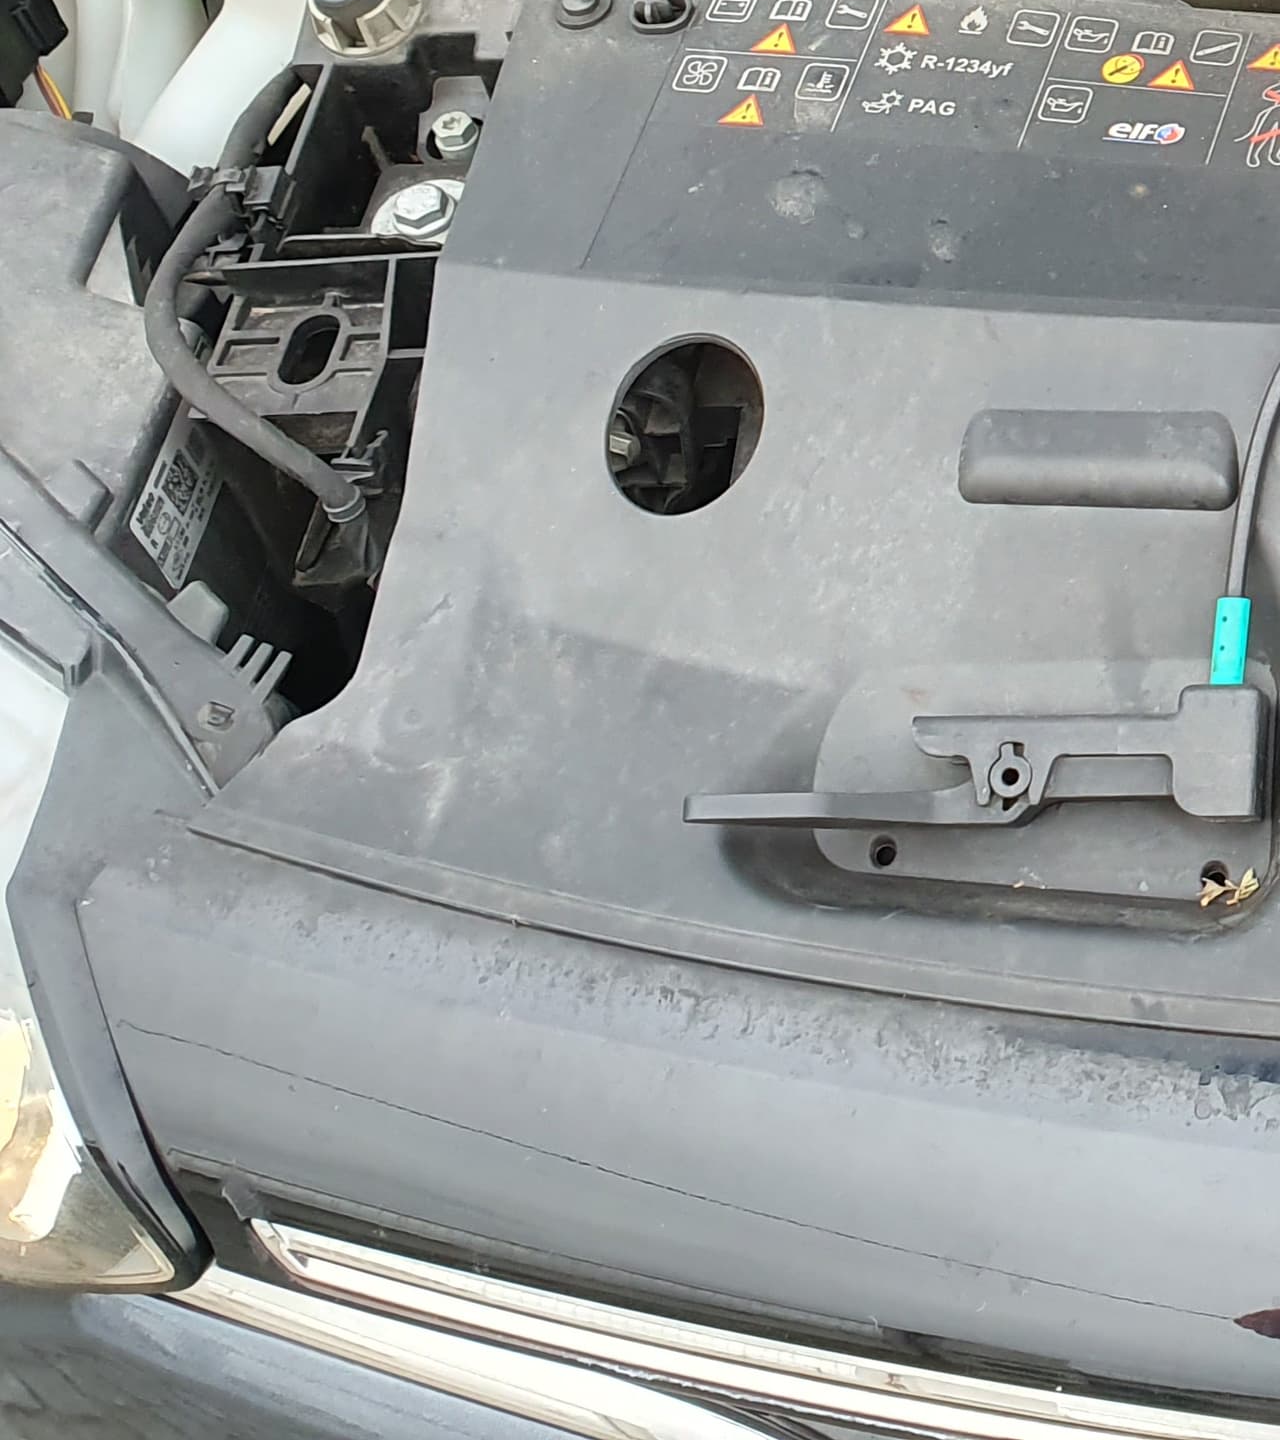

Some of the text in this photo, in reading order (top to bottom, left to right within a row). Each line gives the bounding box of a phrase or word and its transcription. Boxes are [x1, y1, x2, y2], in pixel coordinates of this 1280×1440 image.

[920, 54, 1014, 78] R-1234yf
[907, 99, 956, 116] PAG
[1108, 122, 1158, 140] elf
